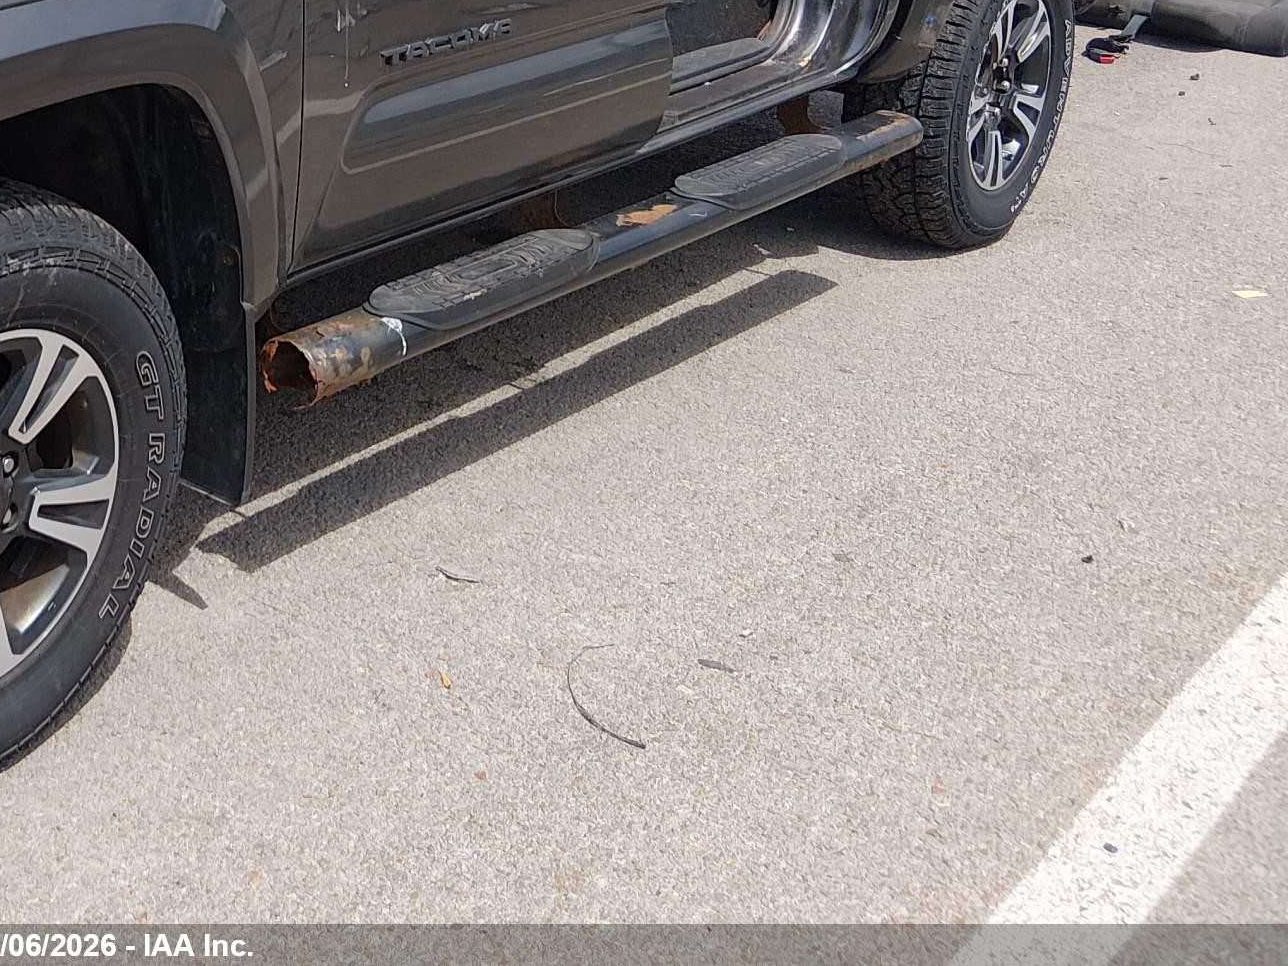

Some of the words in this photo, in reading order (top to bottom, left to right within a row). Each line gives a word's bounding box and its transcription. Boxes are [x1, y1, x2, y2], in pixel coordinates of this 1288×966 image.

[379, 18, 512, 65] TACOMA
[135, 350, 165, 421] GT
[98, 433, 166, 619] RADIAL
